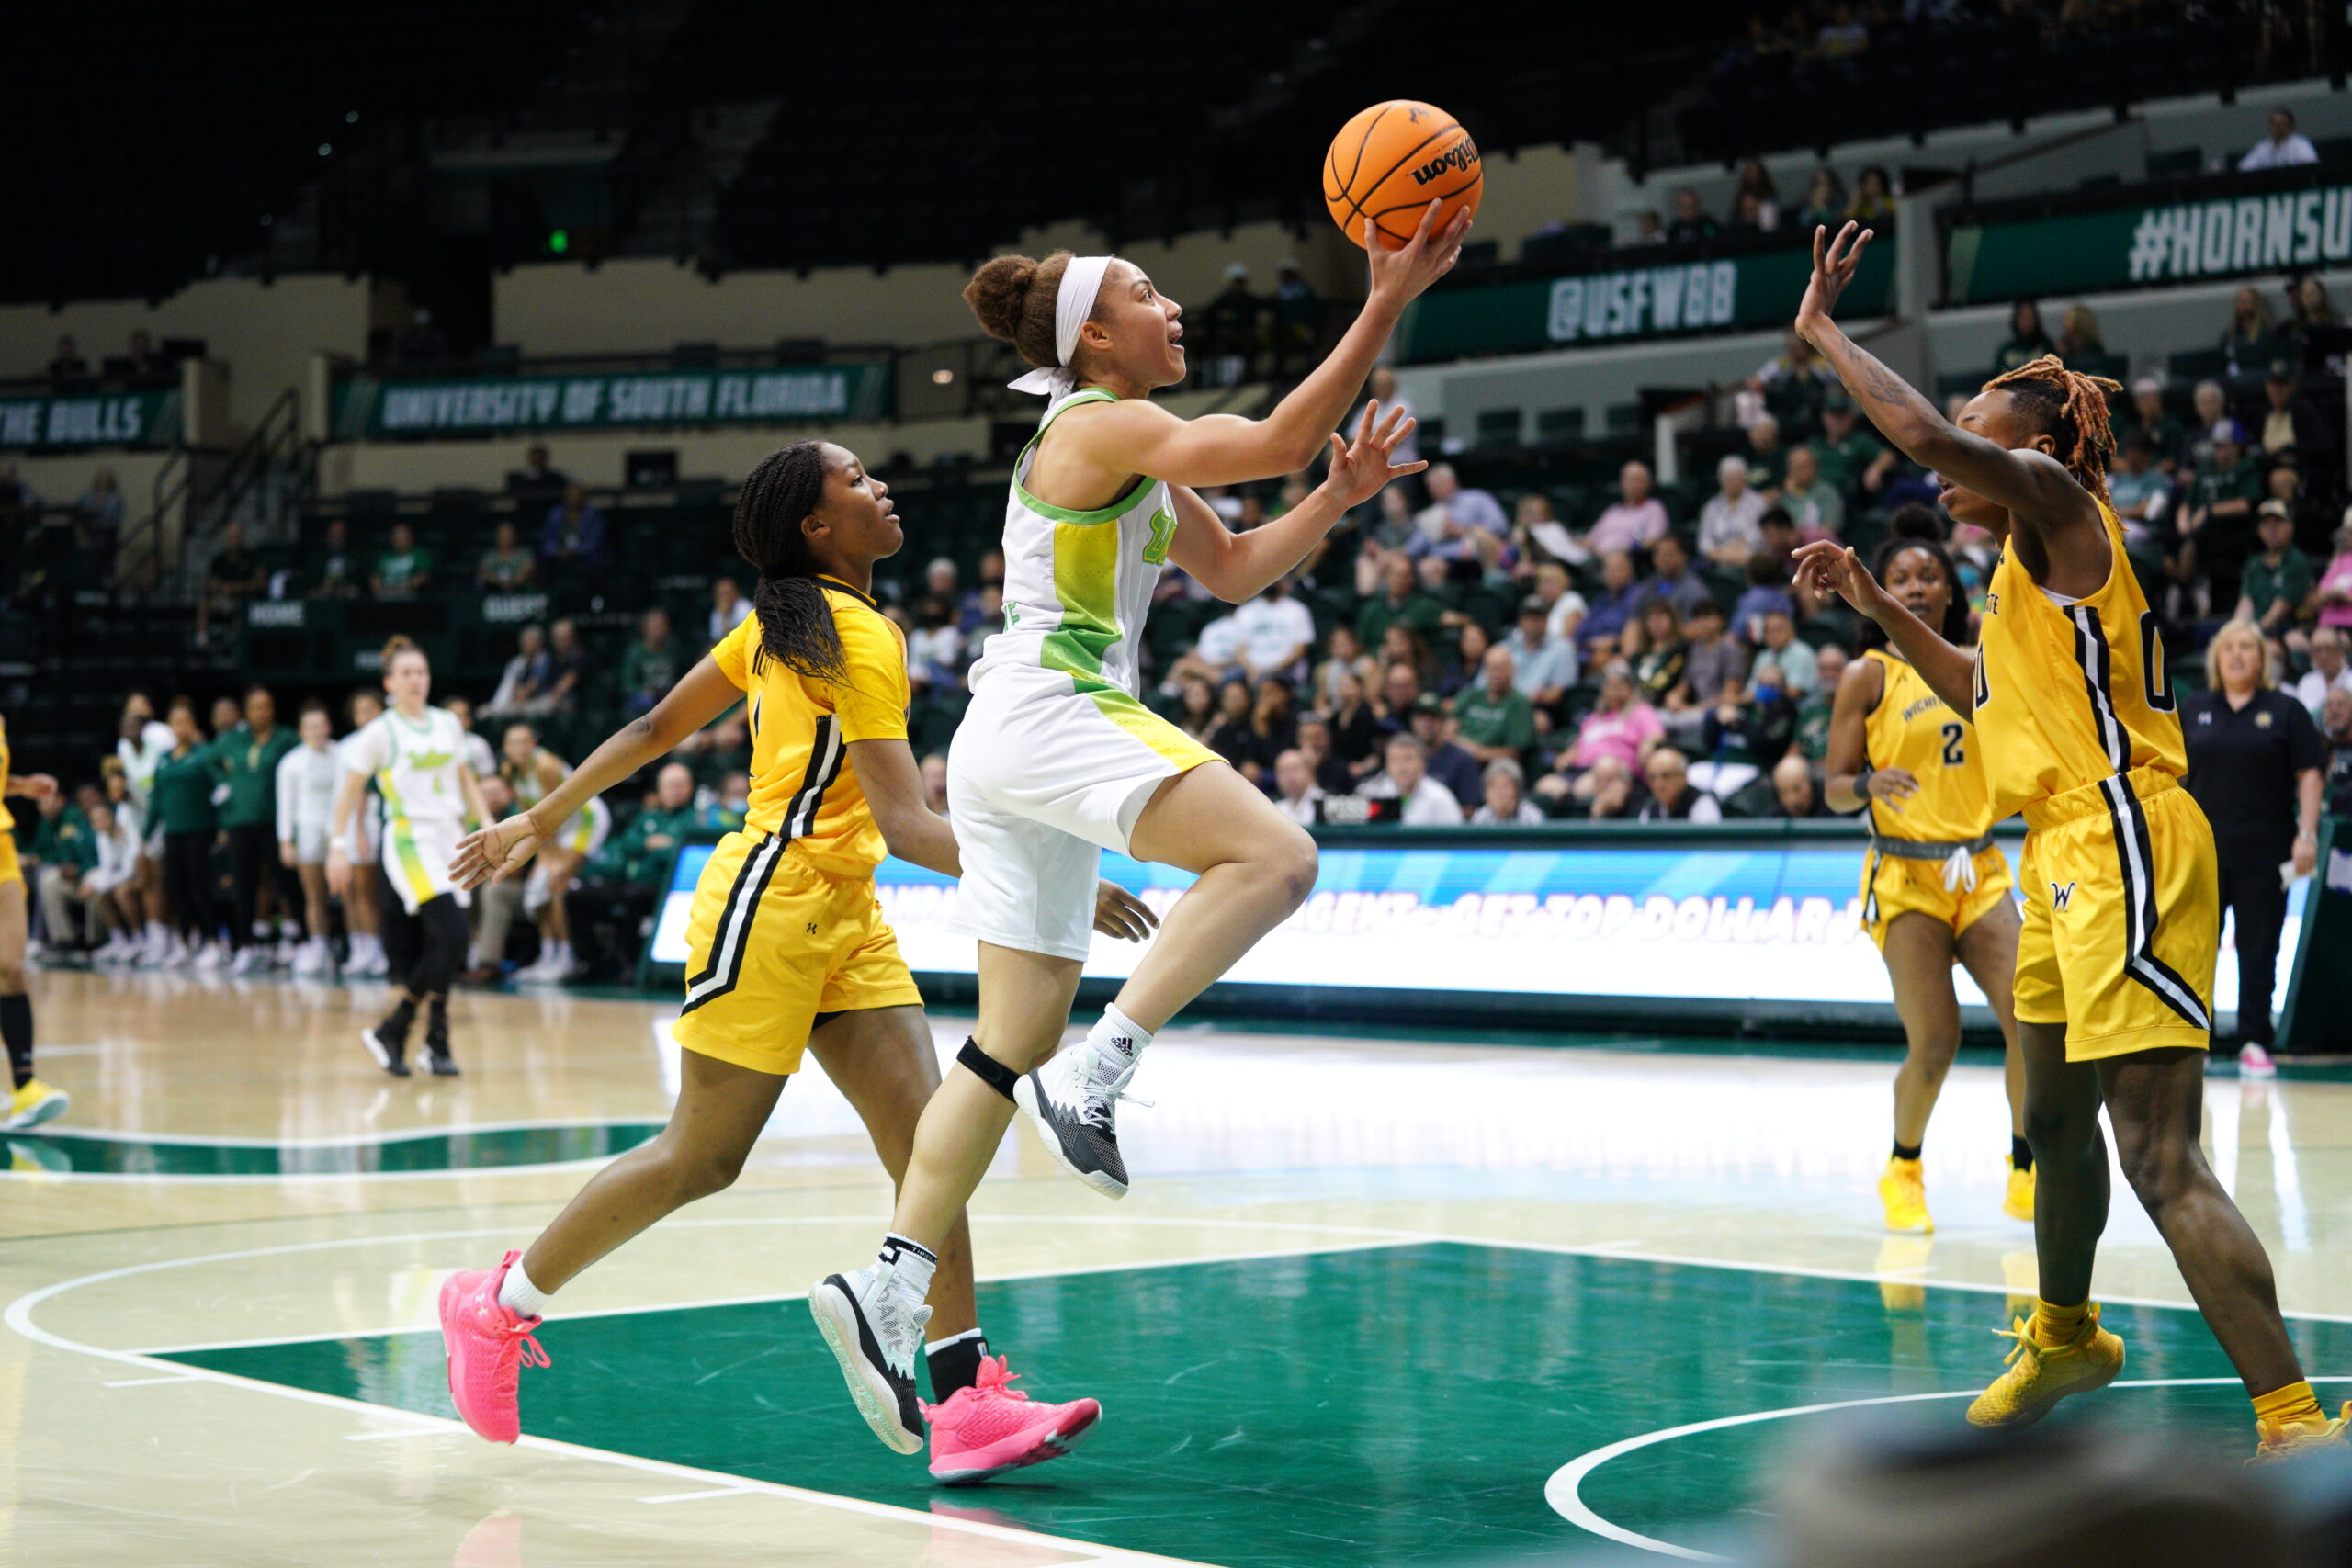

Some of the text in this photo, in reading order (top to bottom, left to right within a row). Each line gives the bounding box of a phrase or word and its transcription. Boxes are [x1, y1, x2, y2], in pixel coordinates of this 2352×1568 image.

[1410, 133, 1479, 186] Wilson
[0, 395, 143, 445] HE BULLS
[382, 371, 847, 429] UNIVERSITY OF SOUTH FLORIDA
[1940, 720, 1965, 768] 2
[2050, 880, 2076, 912] W
[1111, 1037, 1134, 1057] adidas
